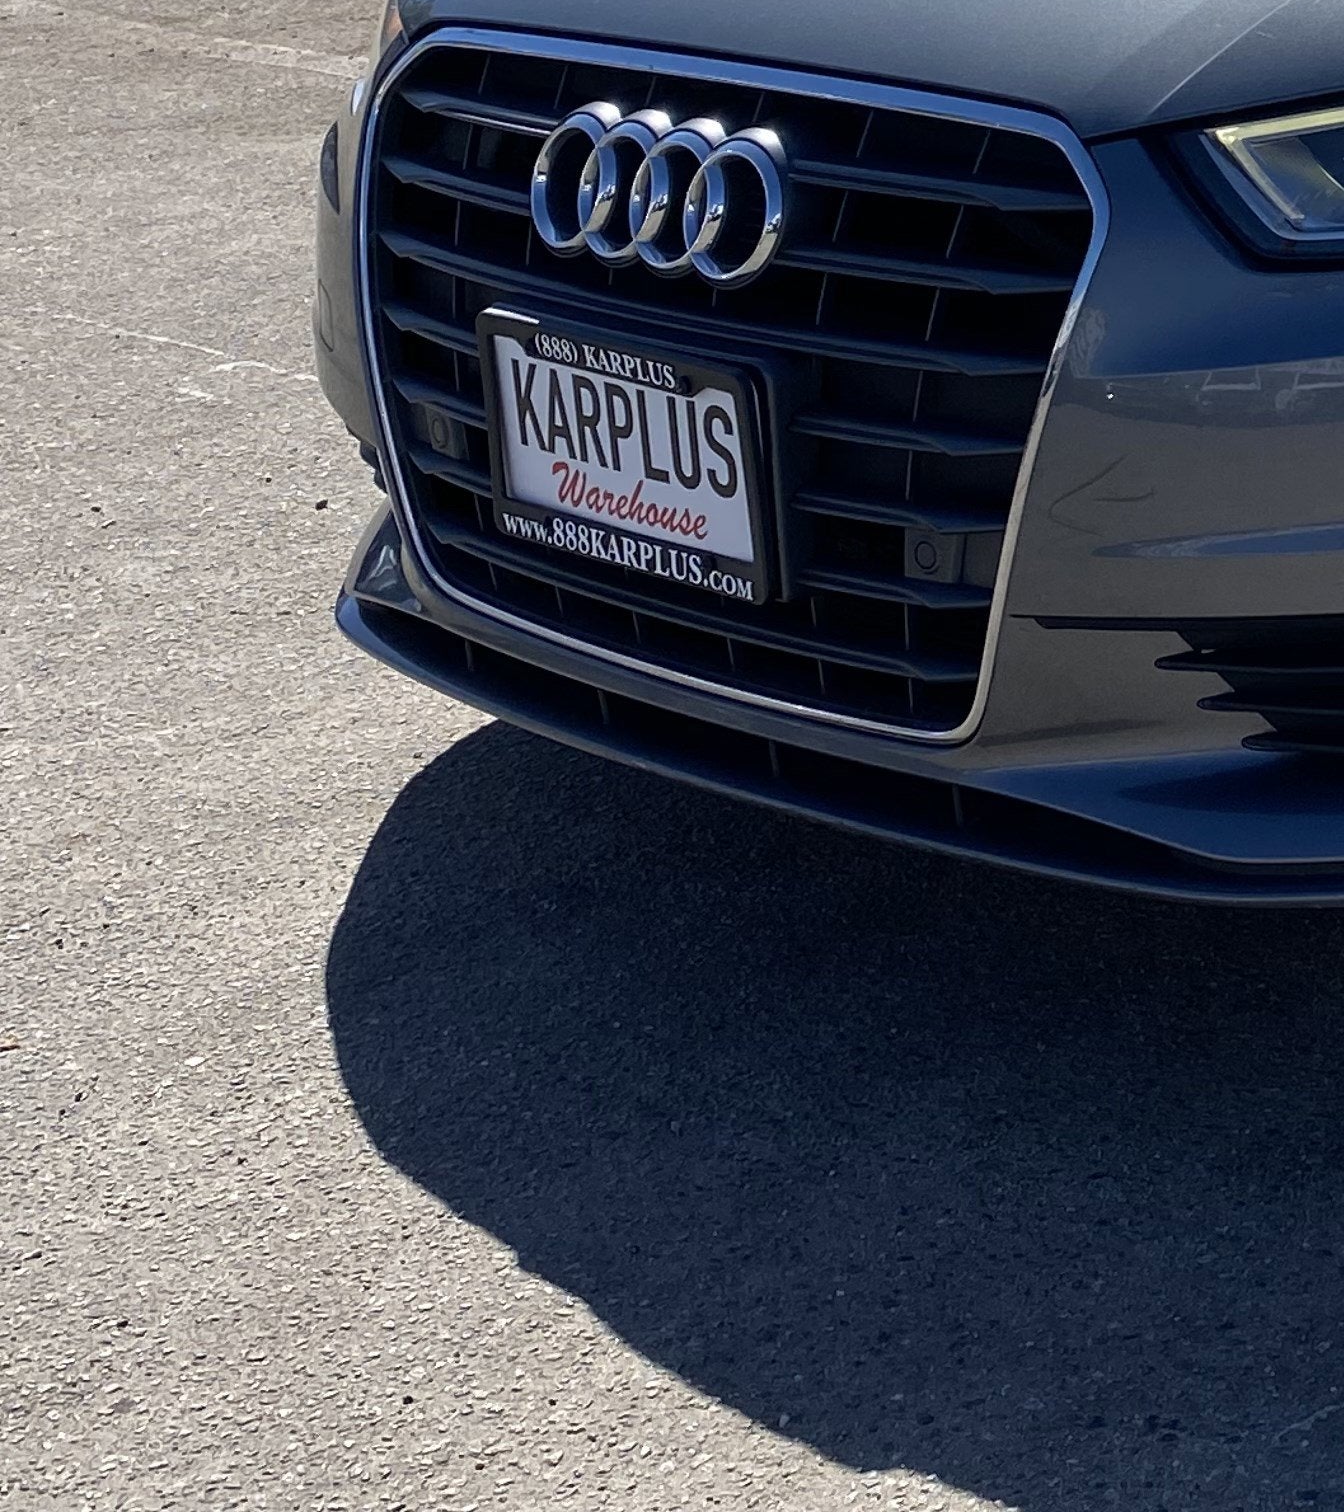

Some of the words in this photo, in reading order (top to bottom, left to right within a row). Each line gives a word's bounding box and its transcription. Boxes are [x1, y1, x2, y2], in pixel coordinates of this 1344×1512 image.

[534, 332, 578, 364] (888)
[582, 344, 677, 389] KARPLUS
[511, 357, 738, 499] KARPLUS
[552, 461, 709, 540] Warehouse
